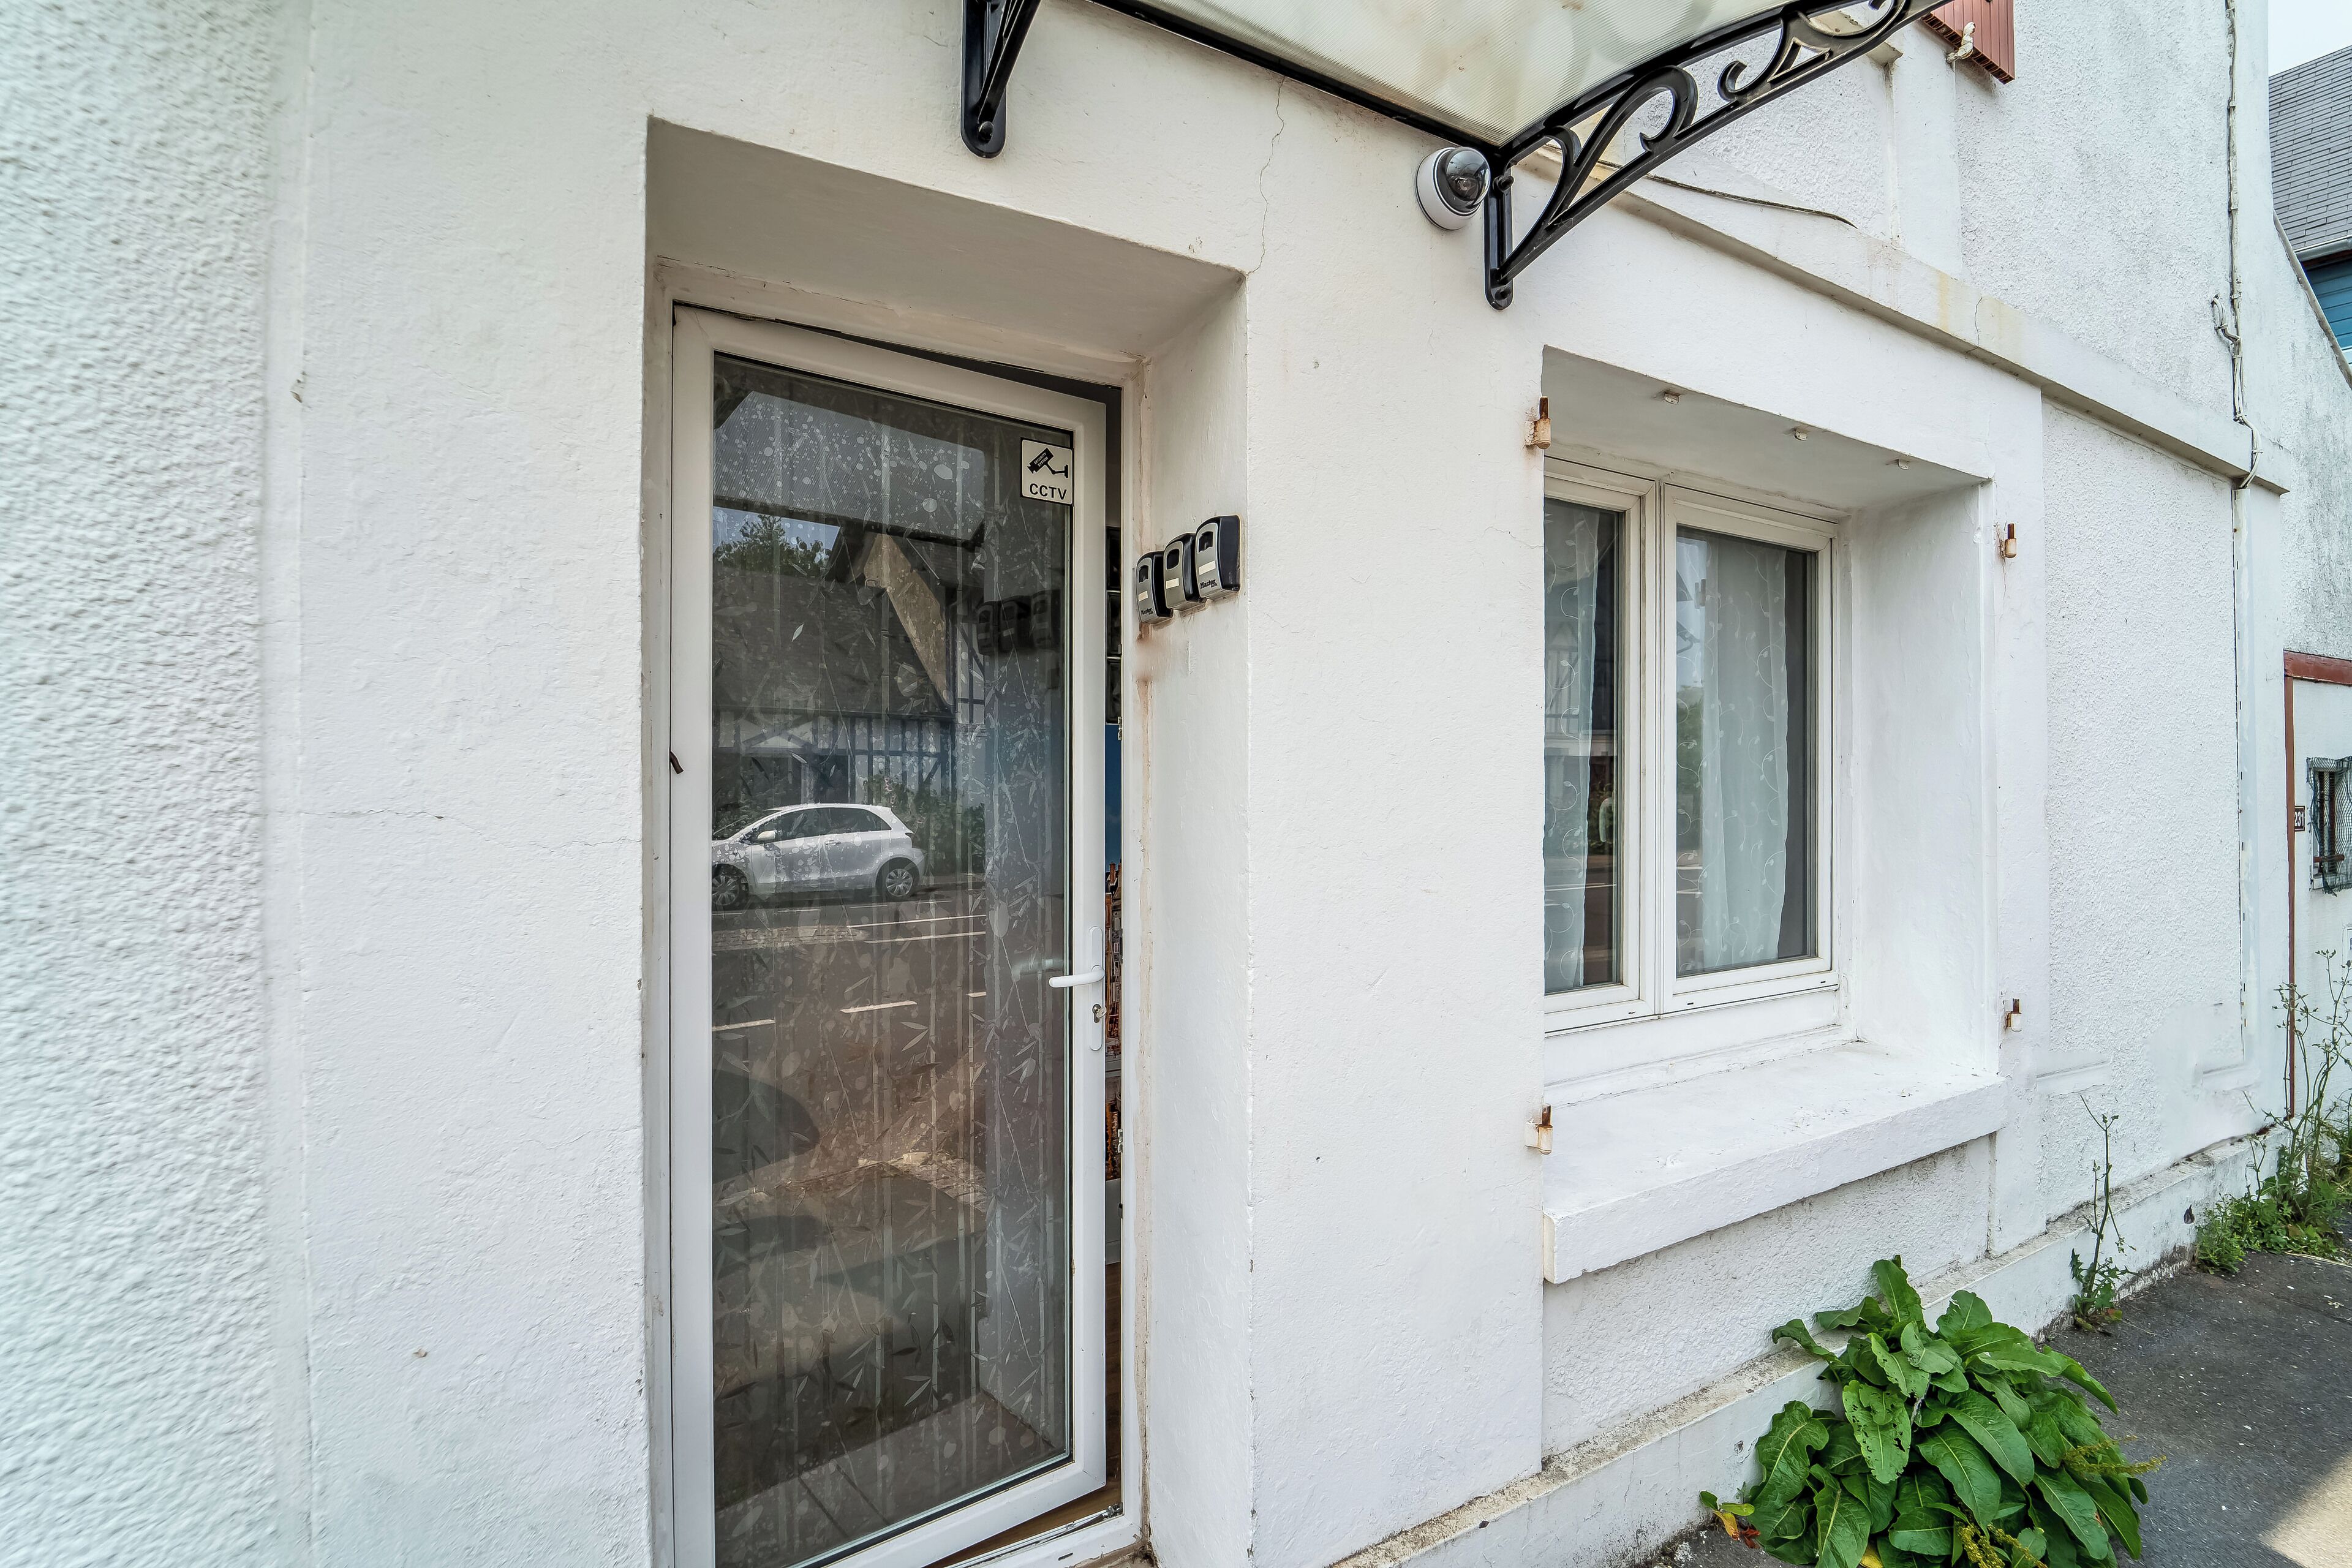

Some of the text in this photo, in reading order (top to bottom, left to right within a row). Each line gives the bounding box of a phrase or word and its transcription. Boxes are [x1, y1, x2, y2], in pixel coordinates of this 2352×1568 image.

[1034, 452, 1047, 465] SECURITY
[1038, 456, 1049, 467] SYSTEM
[1030, 483, 1067, 500] CCTV
[1200, 579, 1216, 589] Master
[2294, 811, 2304, 827] 231
